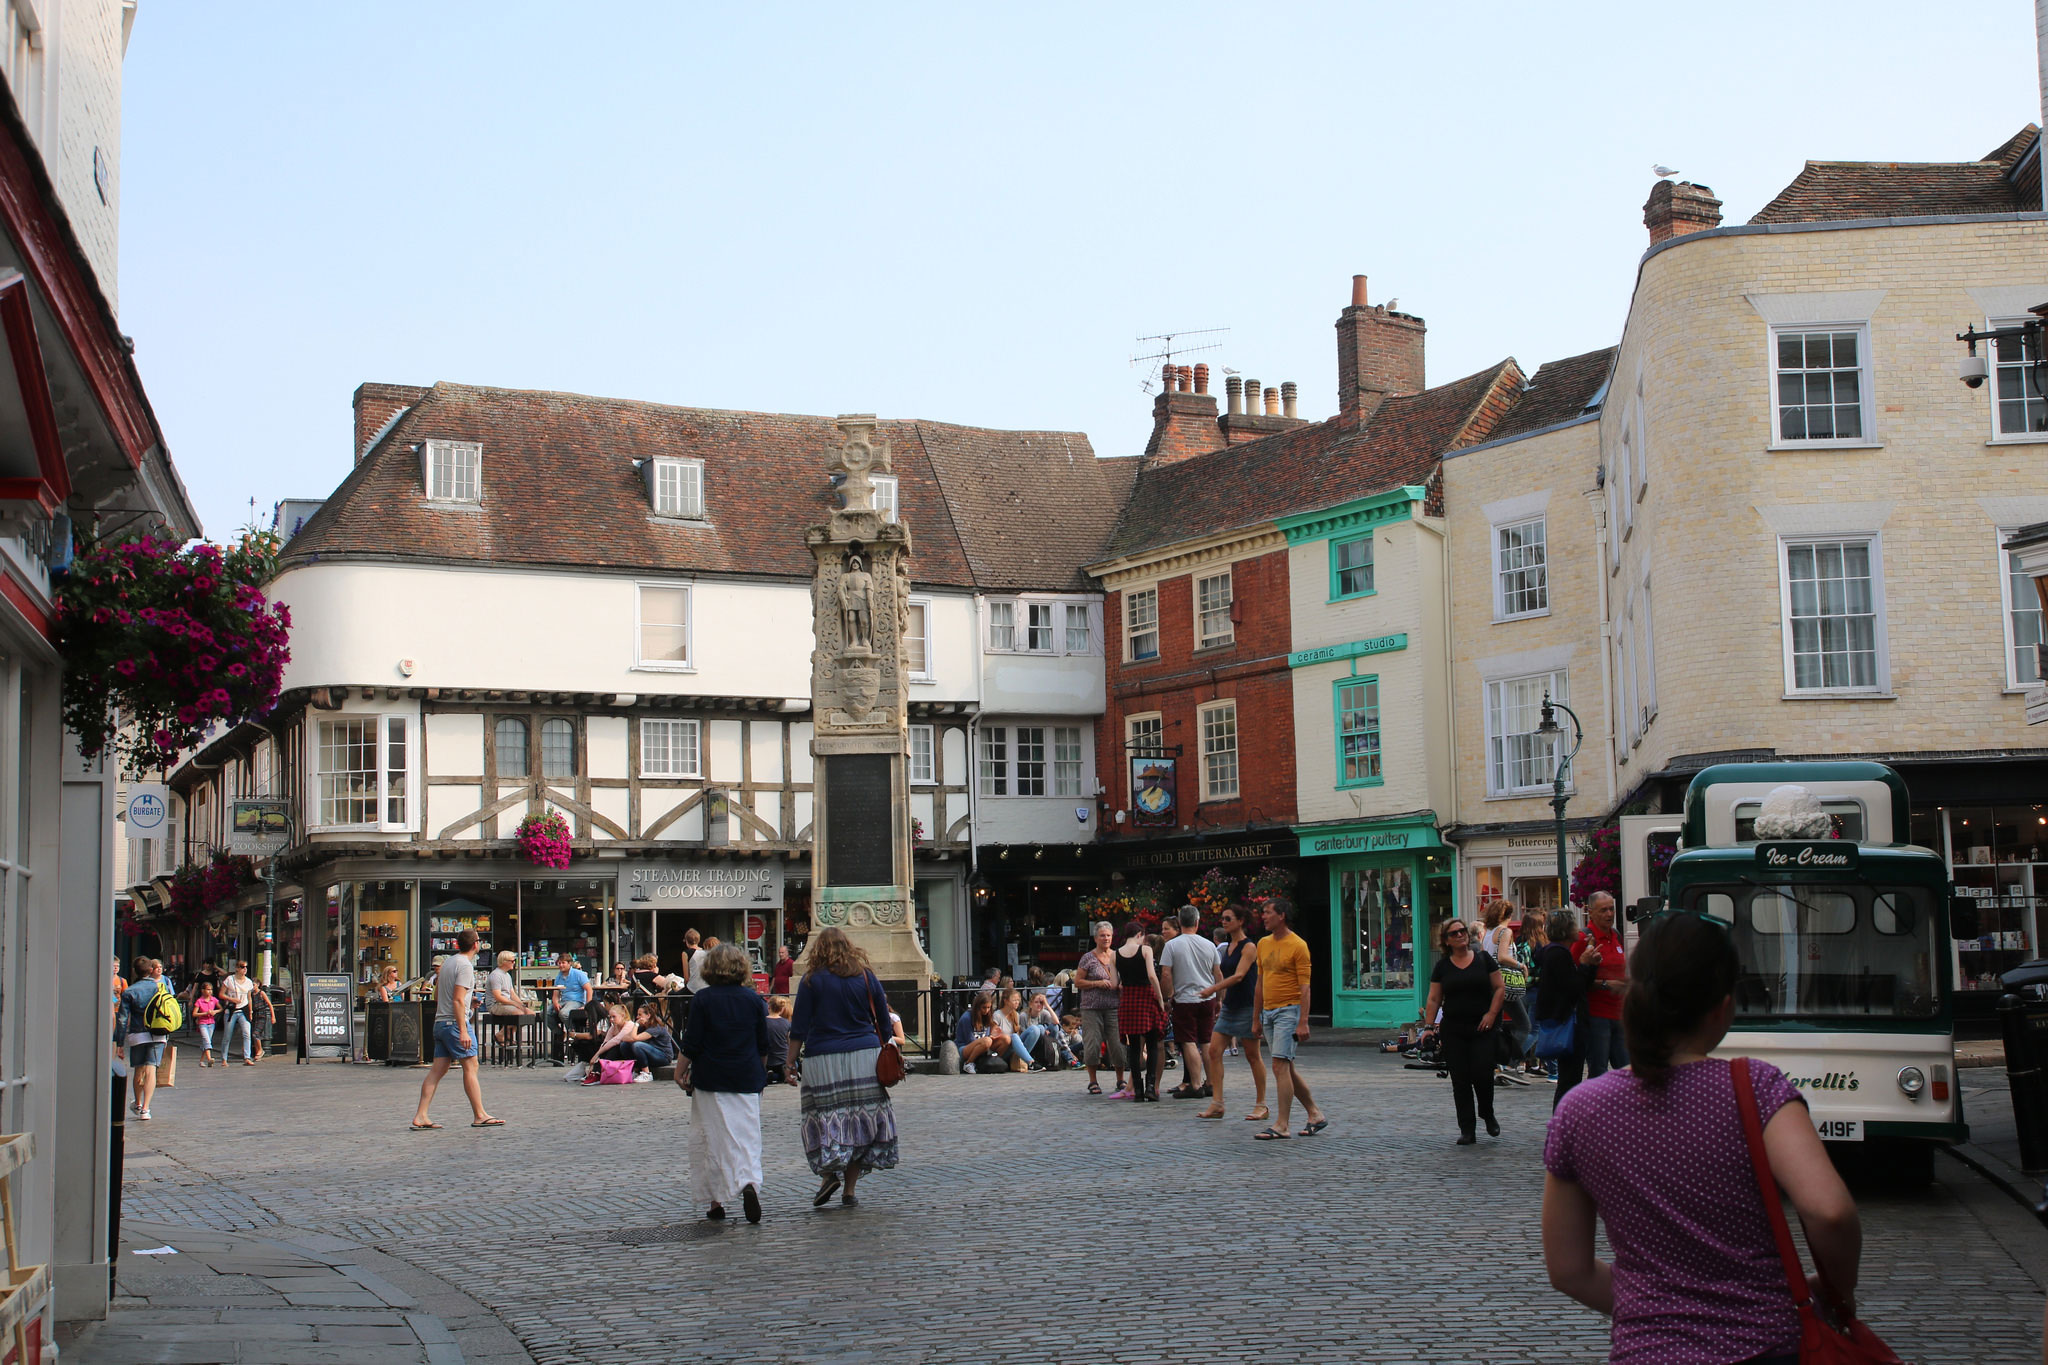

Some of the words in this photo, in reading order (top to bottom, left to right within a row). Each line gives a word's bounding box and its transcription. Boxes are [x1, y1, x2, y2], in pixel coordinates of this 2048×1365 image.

[1297, 648, 1335, 662] ceramic
[1363, 638, 1395, 650] studio
[133, 806, 161, 816] BURGATE
[232, 842, 283, 851] COOKSHO
[1314, 835, 1369, 851] canterbury
[1371, 832, 1409, 850] pottery
[1507, 838, 1558, 848] Buttercups
[1126, 855, 1146, 867] THE
[1151, 853, 1173, 865] OLD
[1177, 843, 1272, 862] BUTTERMARKET
[1766, 846, 1849, 865] Ice-Cream
[632, 869, 701, 882] STEAMER
[706, 868, 771, 882] TRADING
[657, 885, 747, 898] COOKSHOP
[315, 1001, 342, 1009] FAMOUS
[314, 1016, 338, 1025] FISH
[314, 1026, 346, 1035] CHIPS
[1784, 1071, 1860, 1091] orelli's
[1818, 1121, 1857, 1137] 419F
